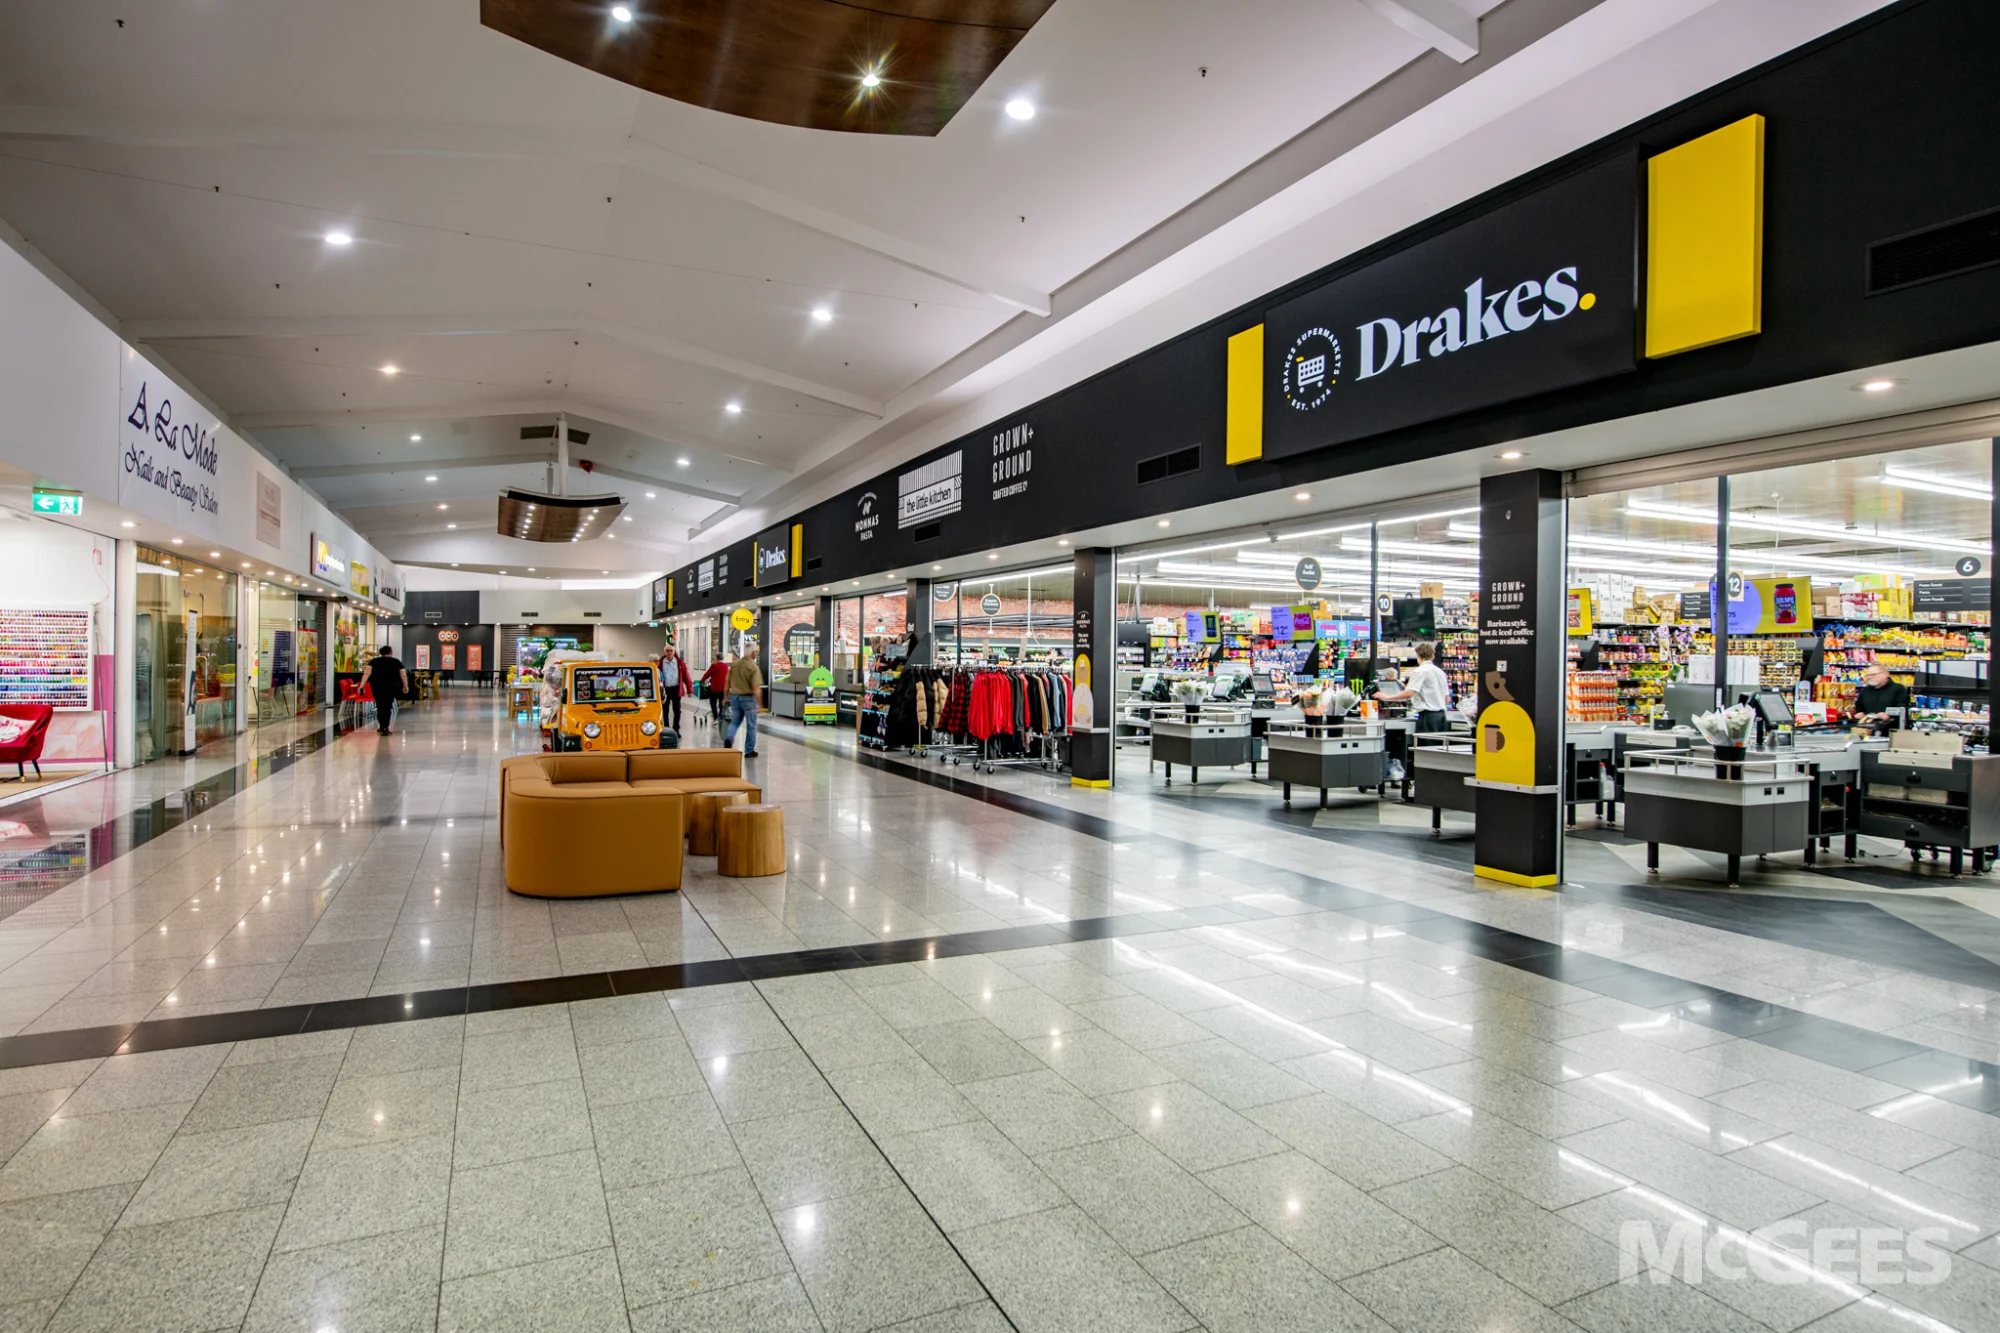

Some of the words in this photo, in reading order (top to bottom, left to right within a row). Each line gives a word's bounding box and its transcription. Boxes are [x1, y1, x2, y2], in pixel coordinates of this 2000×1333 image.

[1355, 266, 1597, 382] Drakes.
[1282, 346, 1297, 393] DRAKES
[1296, 327, 1342, 376] SUPERMARKETS
[1291, 398, 1309, 411] EST.
[1311, 388, 1332, 409] 1974
[127, 380, 150, 435] A
[155, 399, 179, 452] La
[181, 422, 218, 476] Mode
[992, 449, 1032, 484] GROUND
[124, 442, 155, 483] Nails
[154, 465, 170, 490] and
[170, 470, 198, 513] Beauty
[199, 483, 219, 516] Salon
[906, 498, 916, 514] the
[915, 493, 929, 511] little
[928, 486, 952, 506] kitchen
[855, 514, 879, 532] NONNAS
[1962, 560, 1974, 573] 6
[1728, 578, 1740, 592] 12
[1378, 597, 1390, 609] 10
[1491, 592, 1524, 603] GROUND
[735, 616, 750, 625] Entry
[1487, 620, 1510, 628] Barista
[1510, 619, 1527, 629] style
[1480, 628, 1491, 636] hot
[1498, 628, 1513, 636] iced
[1512, 628, 1534, 636] coffee
[1498, 637, 1528, 645] available
